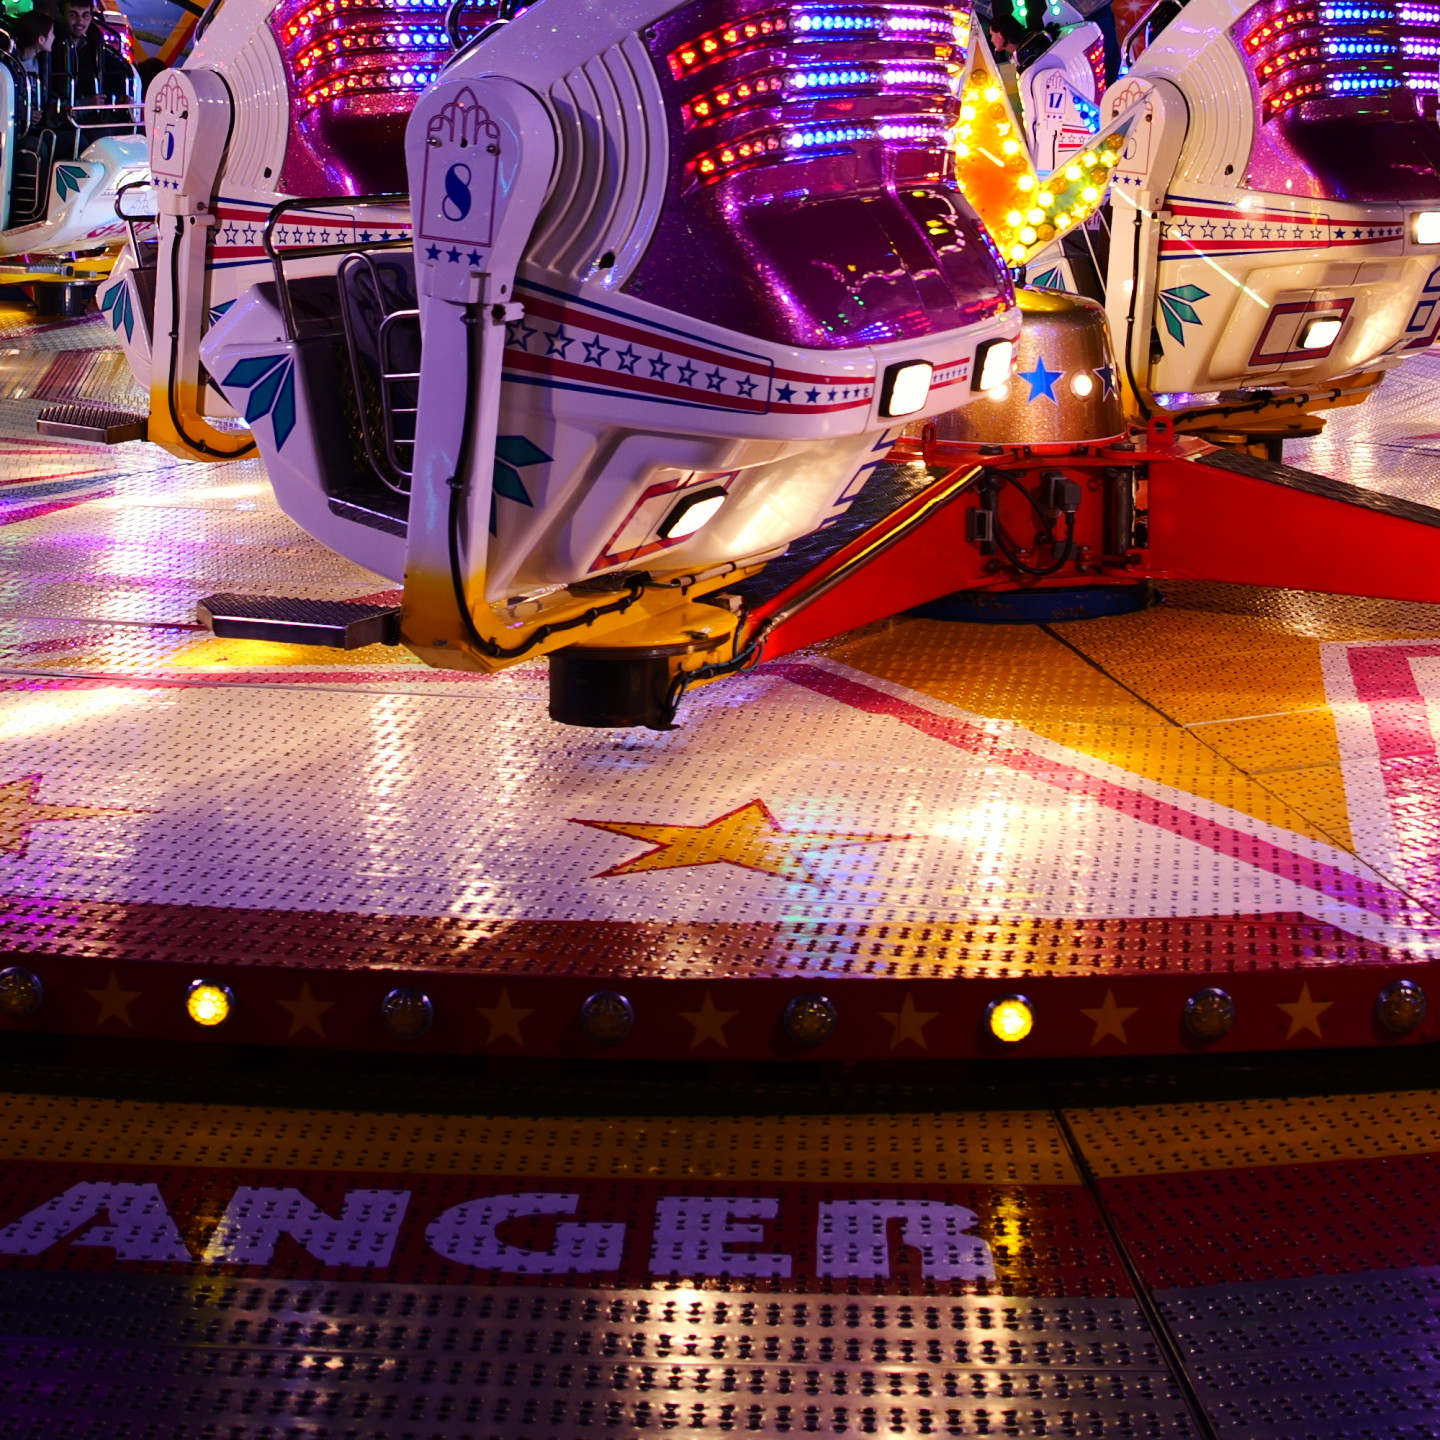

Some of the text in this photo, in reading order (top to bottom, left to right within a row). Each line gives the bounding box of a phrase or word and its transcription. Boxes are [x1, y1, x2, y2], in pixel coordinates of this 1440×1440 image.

[1048, 93, 1063, 108] 17
[160, 123, 175, 161] 5
[441, 163, 473, 223] 8
